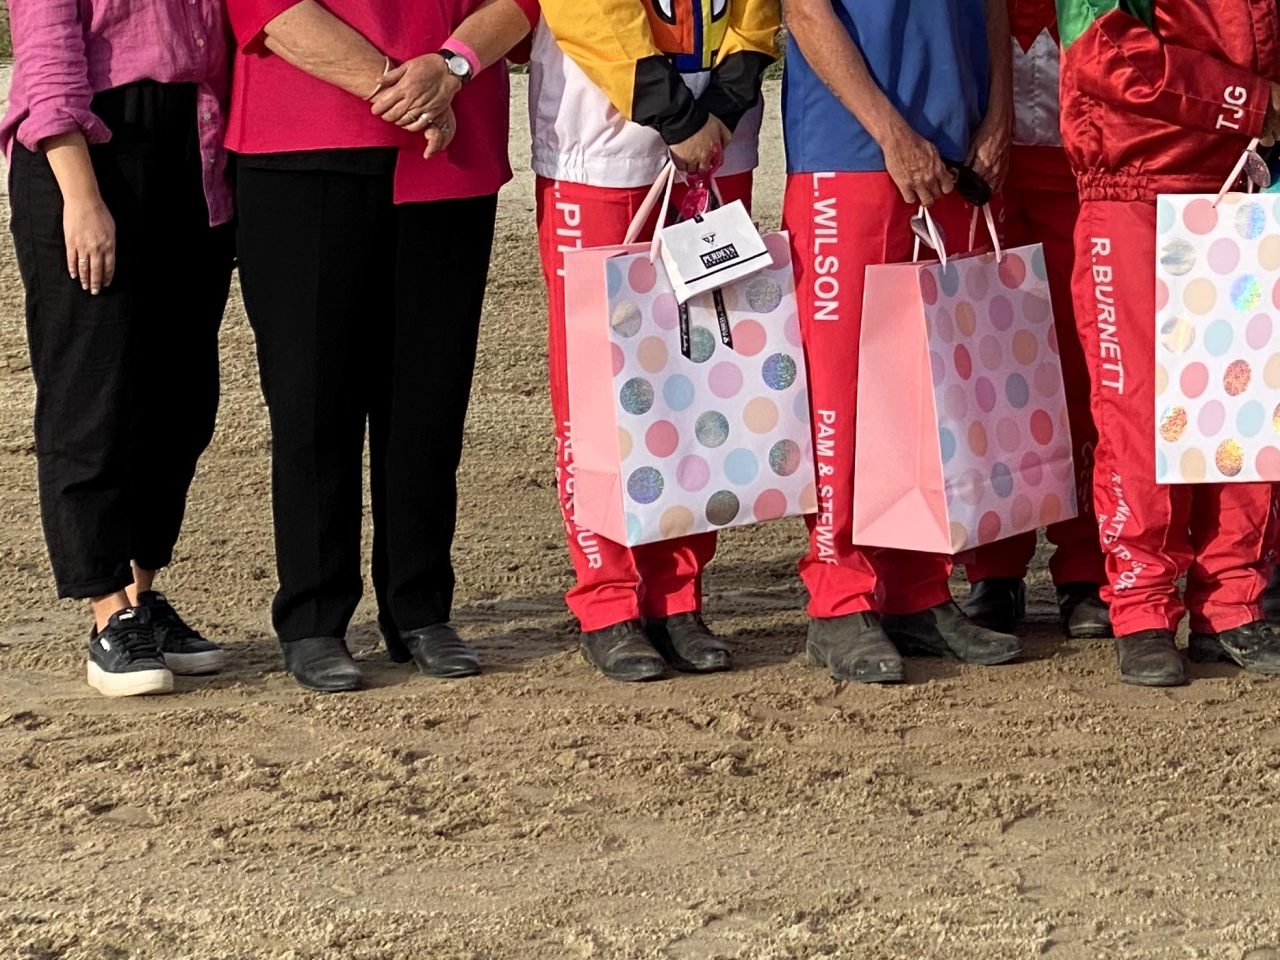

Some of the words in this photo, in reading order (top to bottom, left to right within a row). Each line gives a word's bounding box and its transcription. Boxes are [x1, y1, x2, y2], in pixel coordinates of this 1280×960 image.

[1215, 85, 1247, 130] TJG
[813, 172, 839, 320] L.WILSON
[1089, 237, 1125, 395] R.BURNETT
[817, 409, 837, 457] PAM
[817, 462, 835, 477] &
